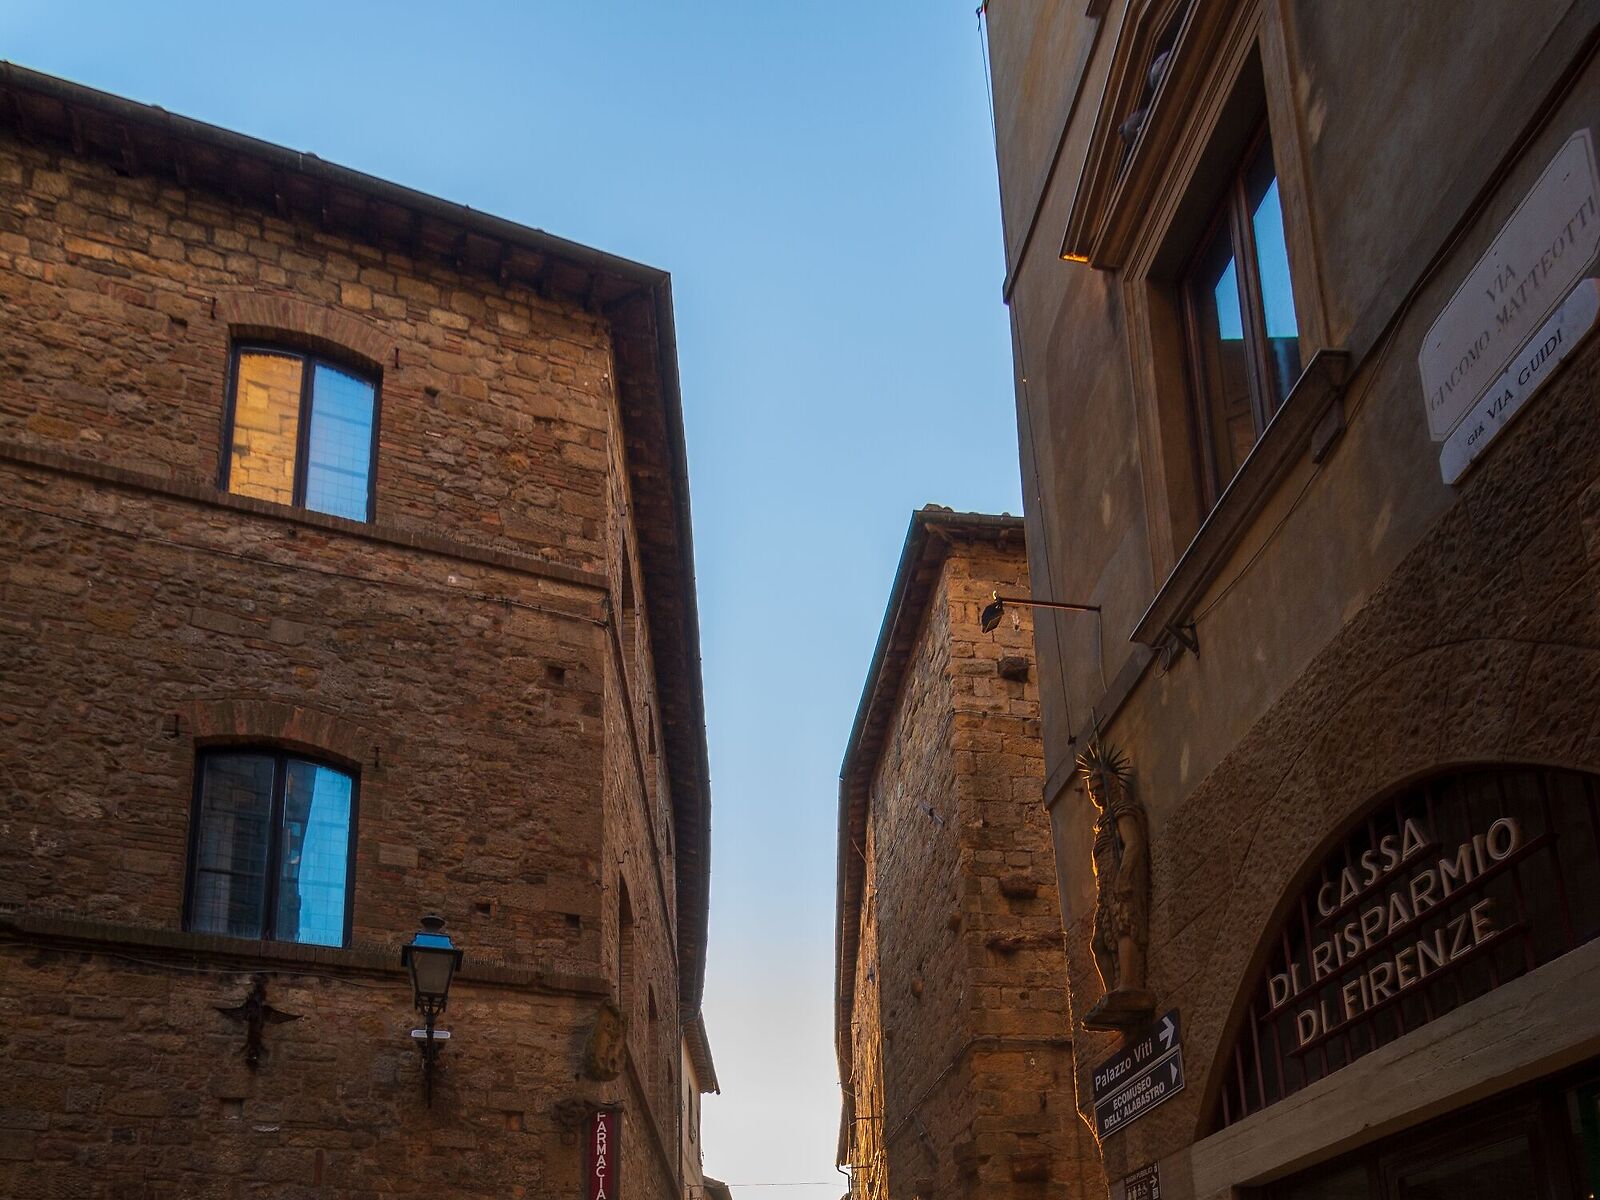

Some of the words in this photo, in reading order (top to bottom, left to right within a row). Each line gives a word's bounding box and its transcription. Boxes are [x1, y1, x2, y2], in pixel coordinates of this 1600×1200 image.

[1430, 330, 1490, 412] GIACOMO
[1495, 194, 1597, 331] MATTEOTTI
[1485, 264, 1516, 303] VIA
[1486, 389, 1514, 420] VIA
[1518, 328, 1564, 386] GUIDI
[1317, 817, 1428, 918] CASSA
[1269, 962, 1302, 1010] DI
[1312, 816, 1522, 983] RISPARMIO
[1297, 999, 1333, 1046] DI
[1343, 896, 1499, 1020] FIRENZE
[1095, 1057, 1132, 1092] Palazzo
[1133, 1037, 1153, 1062] Viti
[1112, 1076, 1152, 1111] ECOMUSEO
[1123, 1081, 1165, 1118] ALABASTRO
[595, 1111, 607, 1200] FARMACIA
